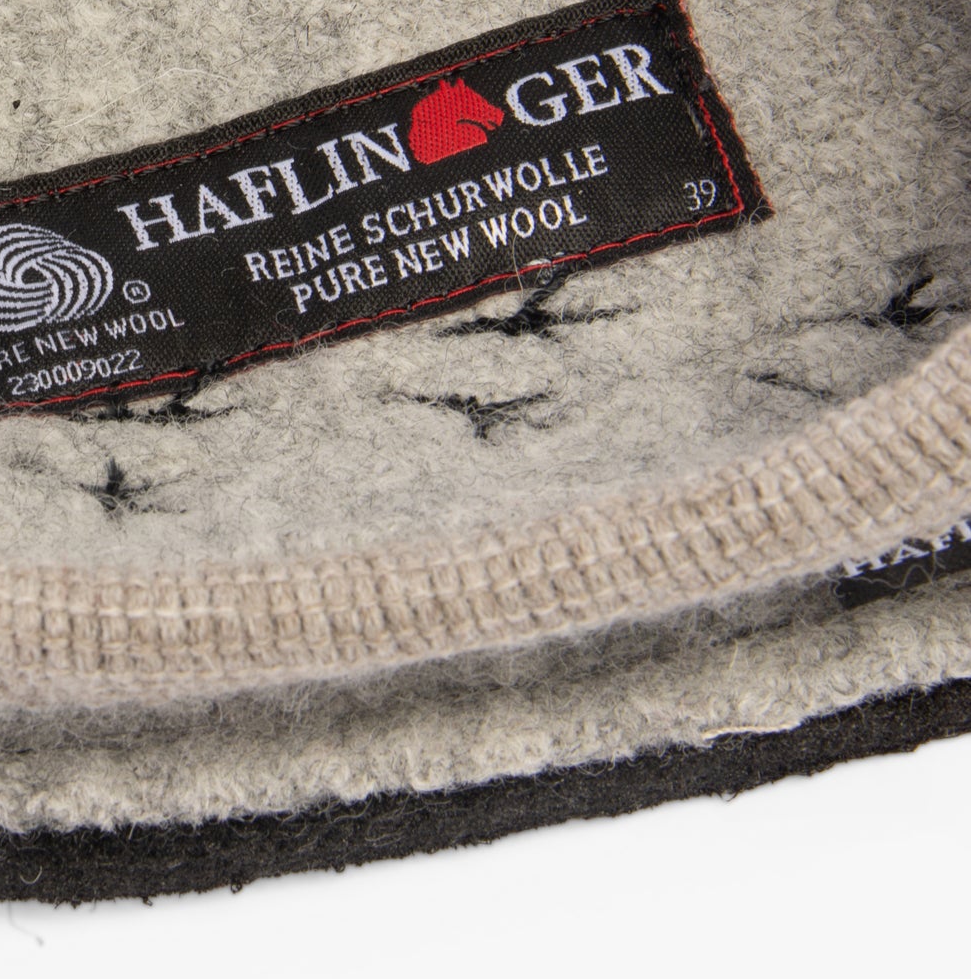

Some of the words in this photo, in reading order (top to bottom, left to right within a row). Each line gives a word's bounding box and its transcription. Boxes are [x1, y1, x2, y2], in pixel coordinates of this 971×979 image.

[244, 221, 355, 282] REINE
[361, 143, 609, 245] SCHURWOLLE
[683, 178, 717, 213] 39
[290, 253, 388, 314] PURE
[395, 227, 471, 280] NEW
[479, 193, 587, 249] WOOL
[34, 325, 99, 356] NEW
[104, 308, 185, 340] WOOL
[8, 348, 144, 396] 230009022
